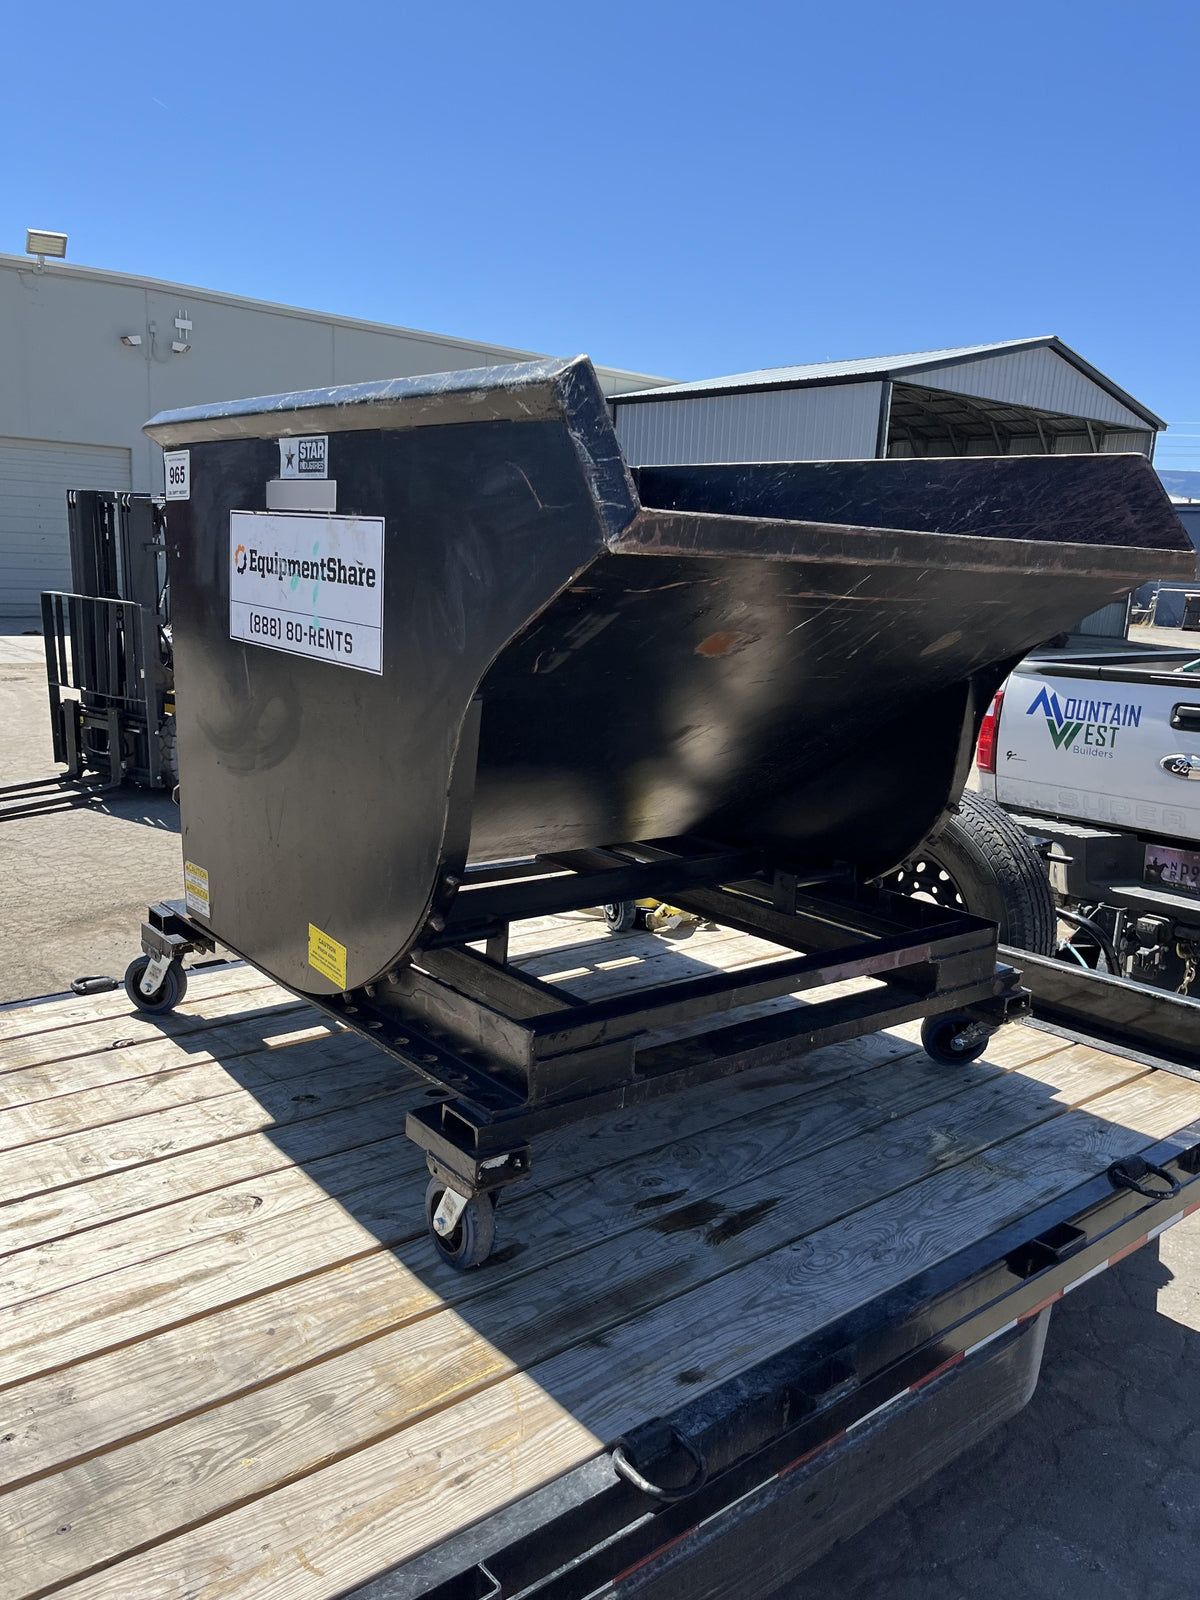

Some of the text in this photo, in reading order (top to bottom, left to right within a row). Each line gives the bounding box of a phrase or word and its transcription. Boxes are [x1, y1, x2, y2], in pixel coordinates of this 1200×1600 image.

[299, 441, 325, 459] STAR
[169, 465, 185, 485] 965
[249, 549, 376, 588] EquipmentShare
[249, 612, 353, 654] (888) 80-RENTS
[1026, 686, 1142, 729] MOUNTAIN
[1046, 718, 1120, 751] WEST
[1073, 745, 1113, 759] Builders
[1058, 791, 1187, 830] SUPER
